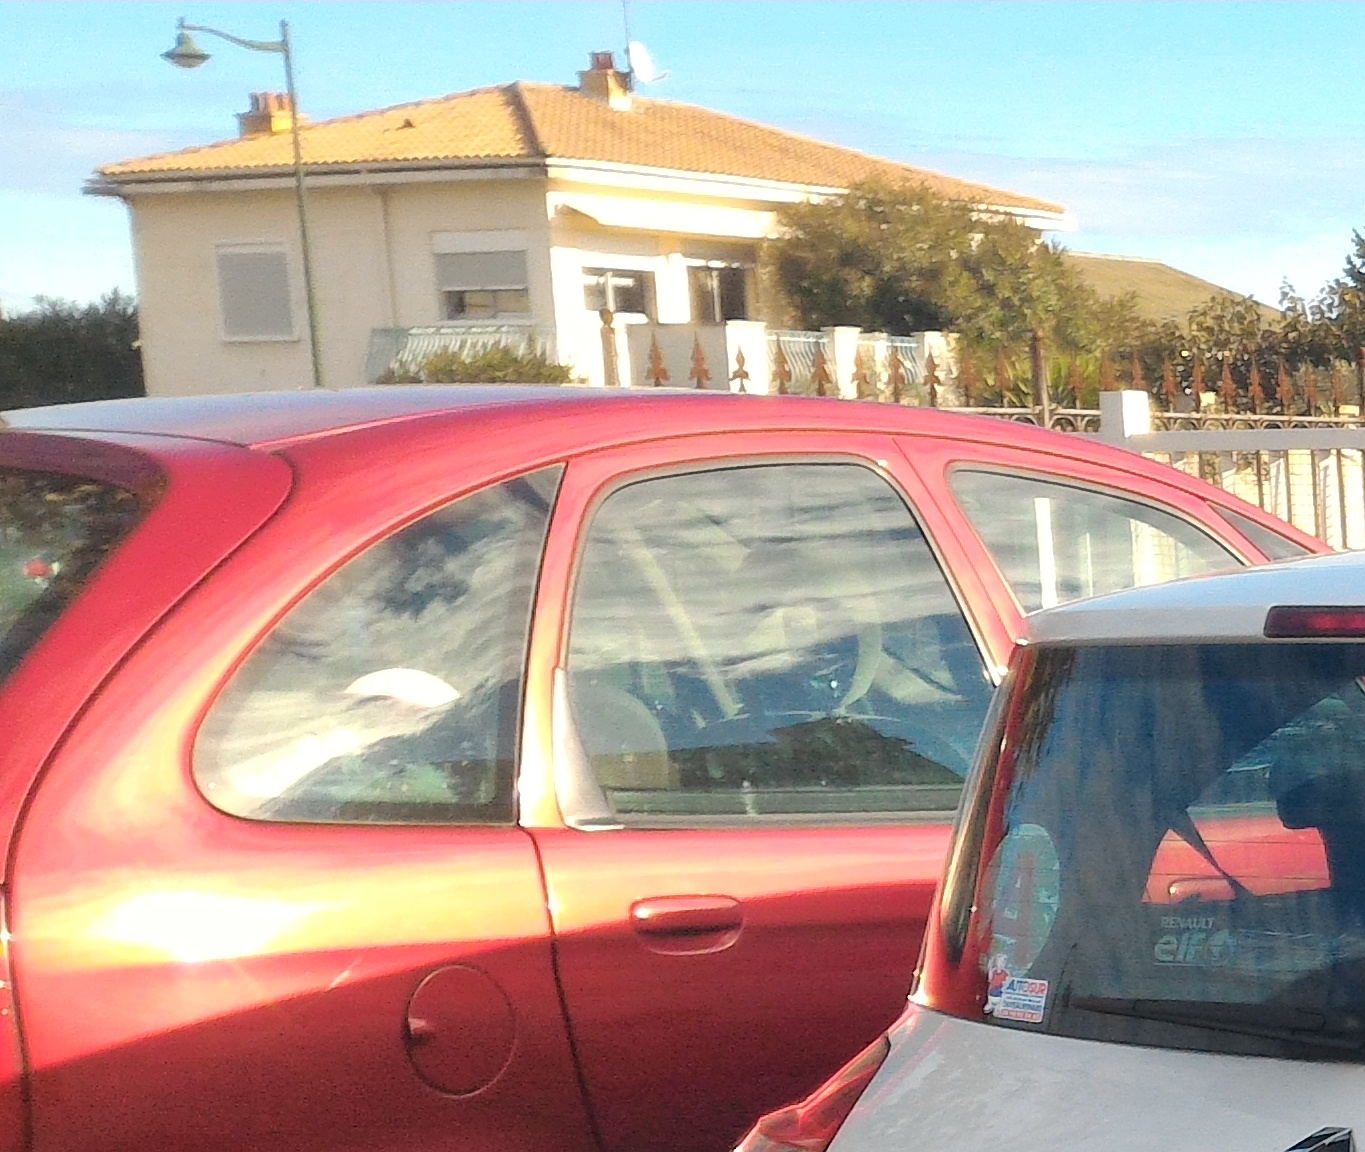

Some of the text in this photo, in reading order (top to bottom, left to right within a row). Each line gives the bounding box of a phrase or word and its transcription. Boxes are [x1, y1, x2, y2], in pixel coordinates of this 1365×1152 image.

[1160, 916, 1215, 930] RENAULT
[1154, 931, 1207, 963] elf
[1006, 979, 1047, 995] AUTOSUR
